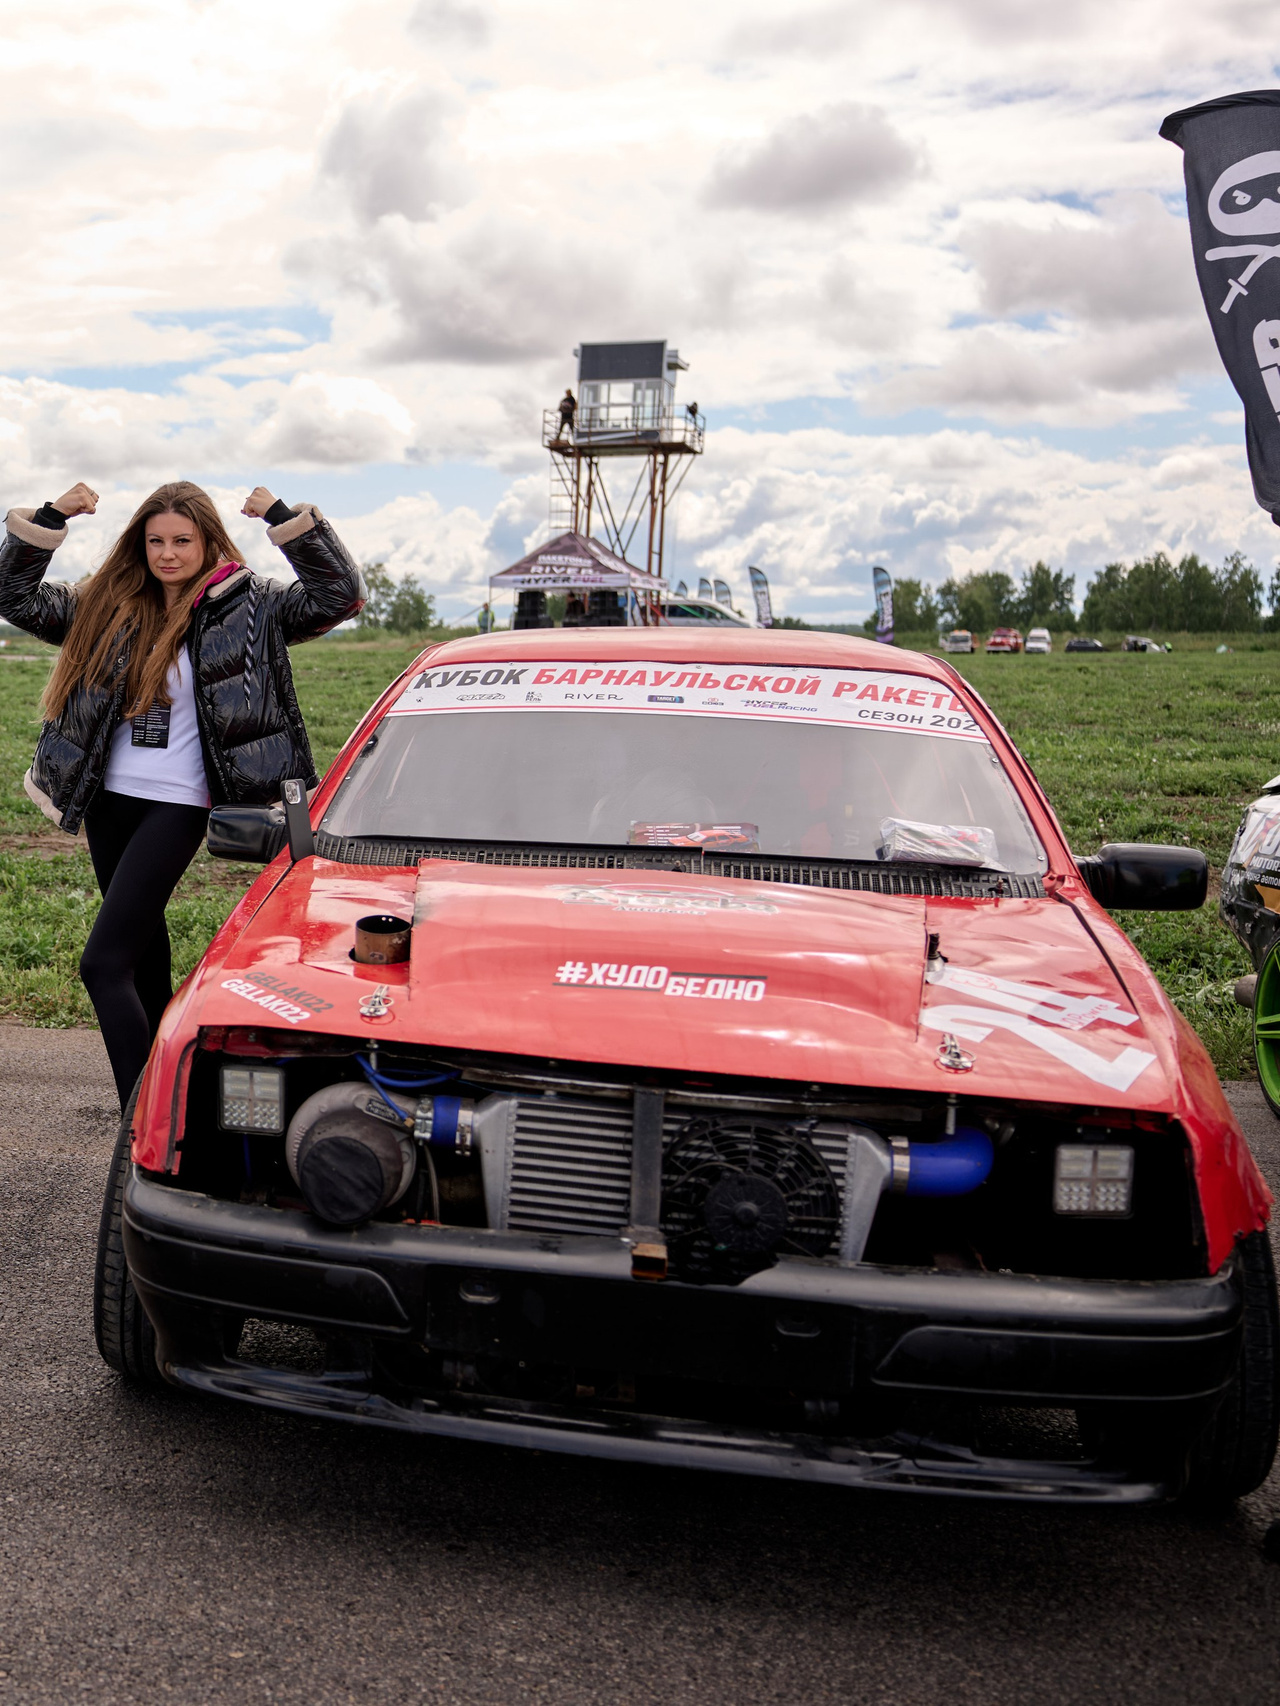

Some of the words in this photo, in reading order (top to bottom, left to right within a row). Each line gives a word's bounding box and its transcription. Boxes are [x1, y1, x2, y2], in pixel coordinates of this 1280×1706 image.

[413, 668, 529, 690] КУБОК
[532, 668, 822, 696] БАРНАУЛЬСКОЙ
[565, 693, 623, 701] RIVER
[858, 709, 923, 725] СЕЗОН
[929, 714, 981, 732] 202
[221, 978, 311, 1024] GELLAKI22
[245, 971, 334, 1013] GELLAKI22
